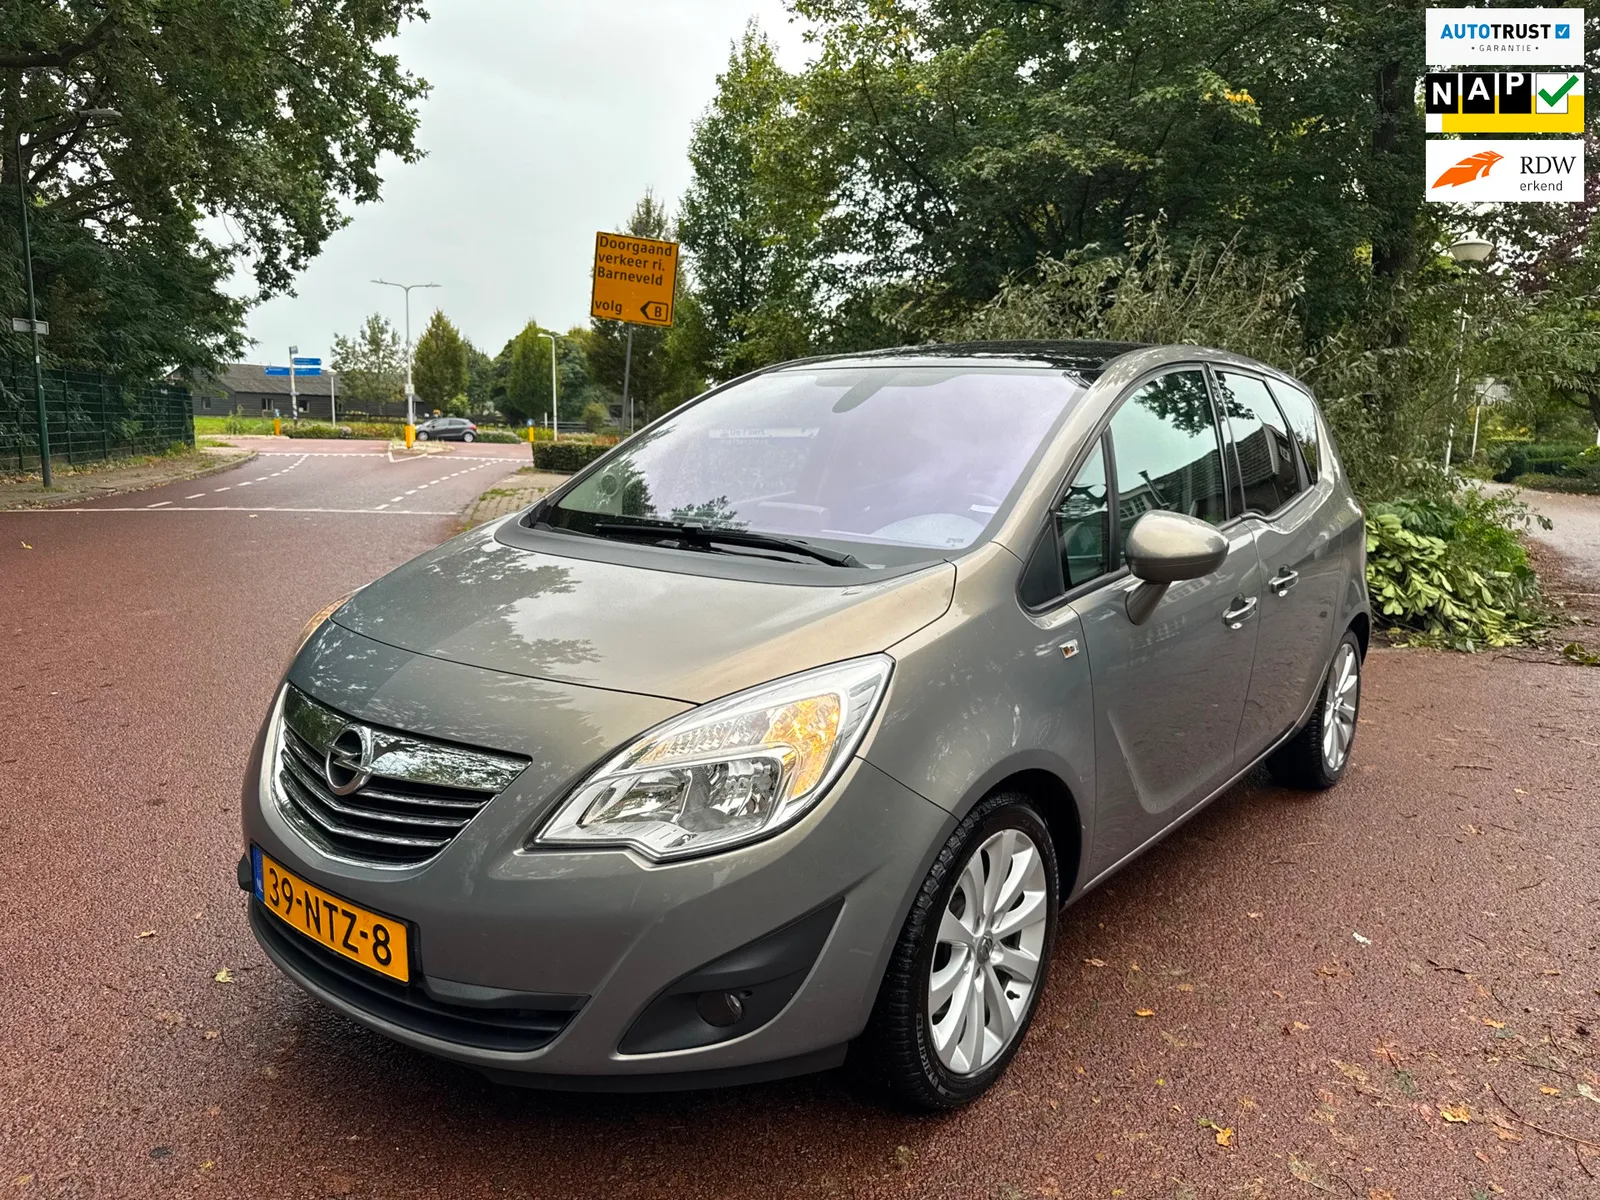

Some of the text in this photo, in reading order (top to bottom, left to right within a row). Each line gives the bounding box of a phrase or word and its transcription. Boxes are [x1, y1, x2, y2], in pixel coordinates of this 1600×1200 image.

[599, 236, 672, 257] Doorgaand
[598, 253, 665, 271] verkeer ri.
[597, 266, 663, 286] Barneveld
[595, 300, 662, 317] volg B
[269, 867, 392, 966] 39-NTZ-8
